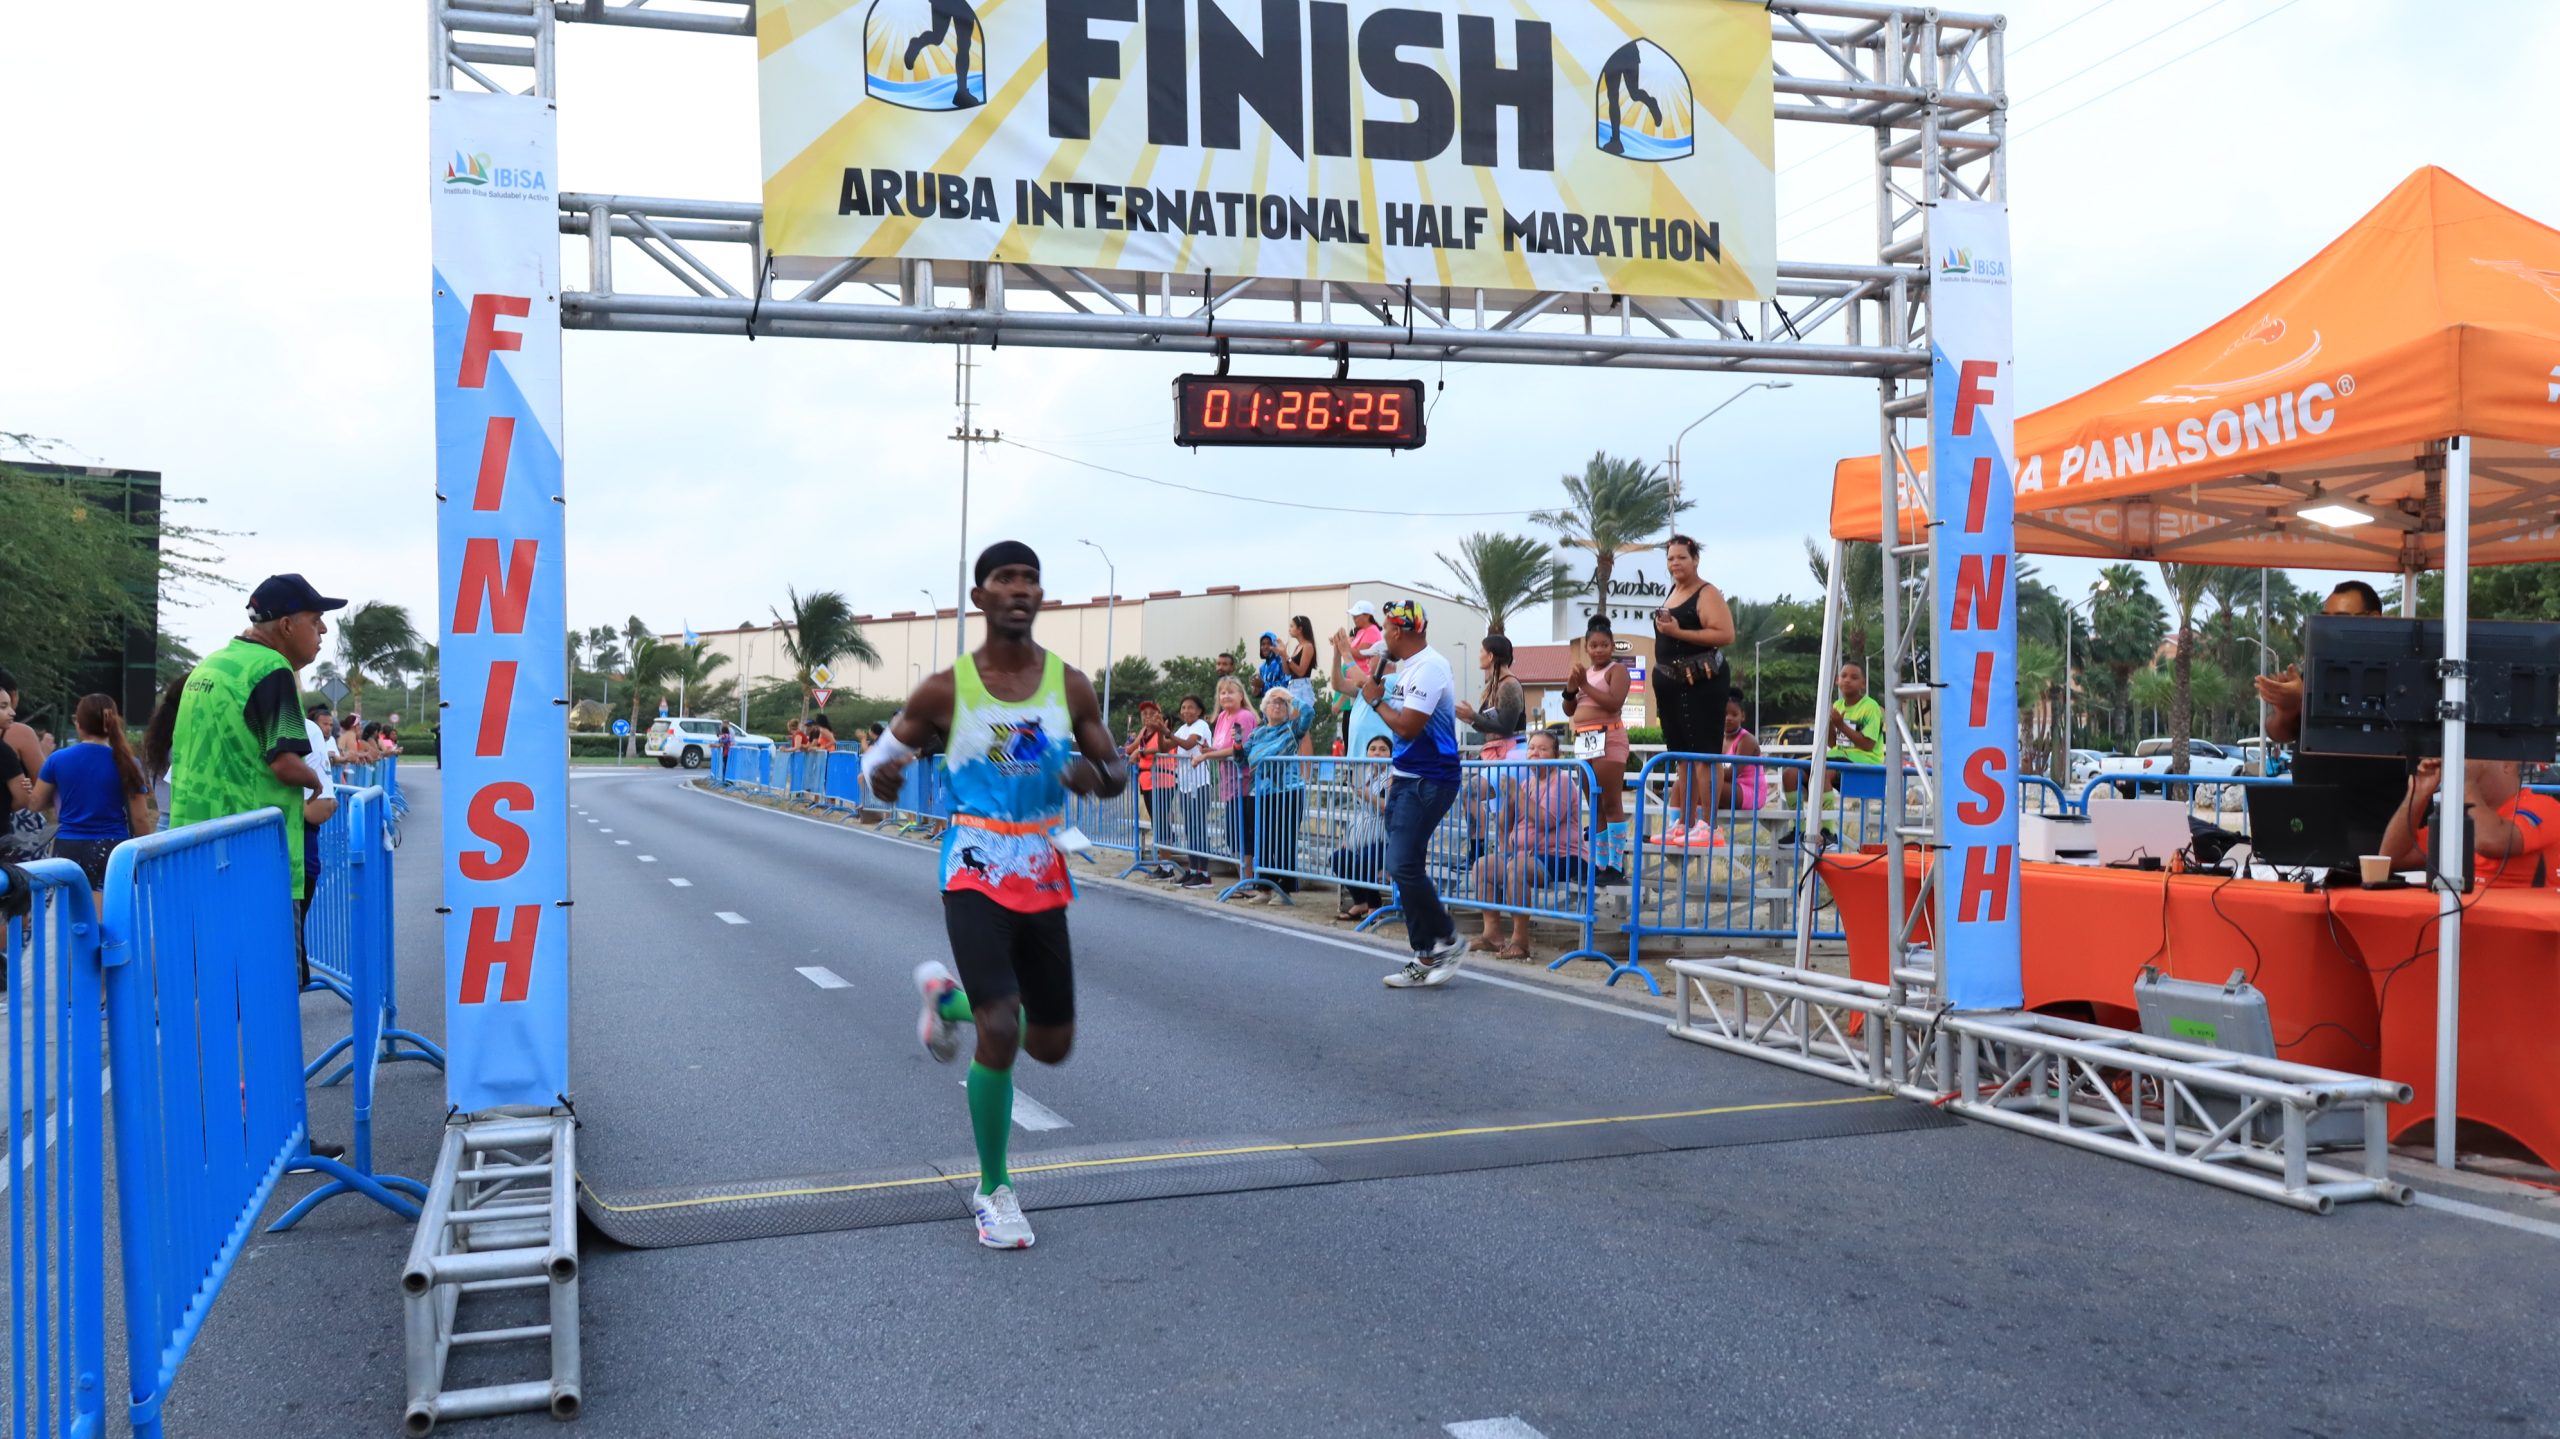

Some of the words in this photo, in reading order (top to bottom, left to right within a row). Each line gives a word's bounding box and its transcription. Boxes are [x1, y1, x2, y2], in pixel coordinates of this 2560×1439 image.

[1046, 0, 1554, 172] FINISH
[494, 167, 547, 190] IBiSA
[838, 167, 1000, 224] ARUBA
[1015, 178, 1370, 245] INTERNATIONAL
[1385, 202, 1488, 250] HALF
[1503, 207, 1721, 265] MARATHON
[1974, 259, 2005, 276] IBiSA
[1203, 389, 1400, 432] 01:26:25
[452, 293, 541, 1004] FINISH
[1950, 360, 2012, 923] FINISH
